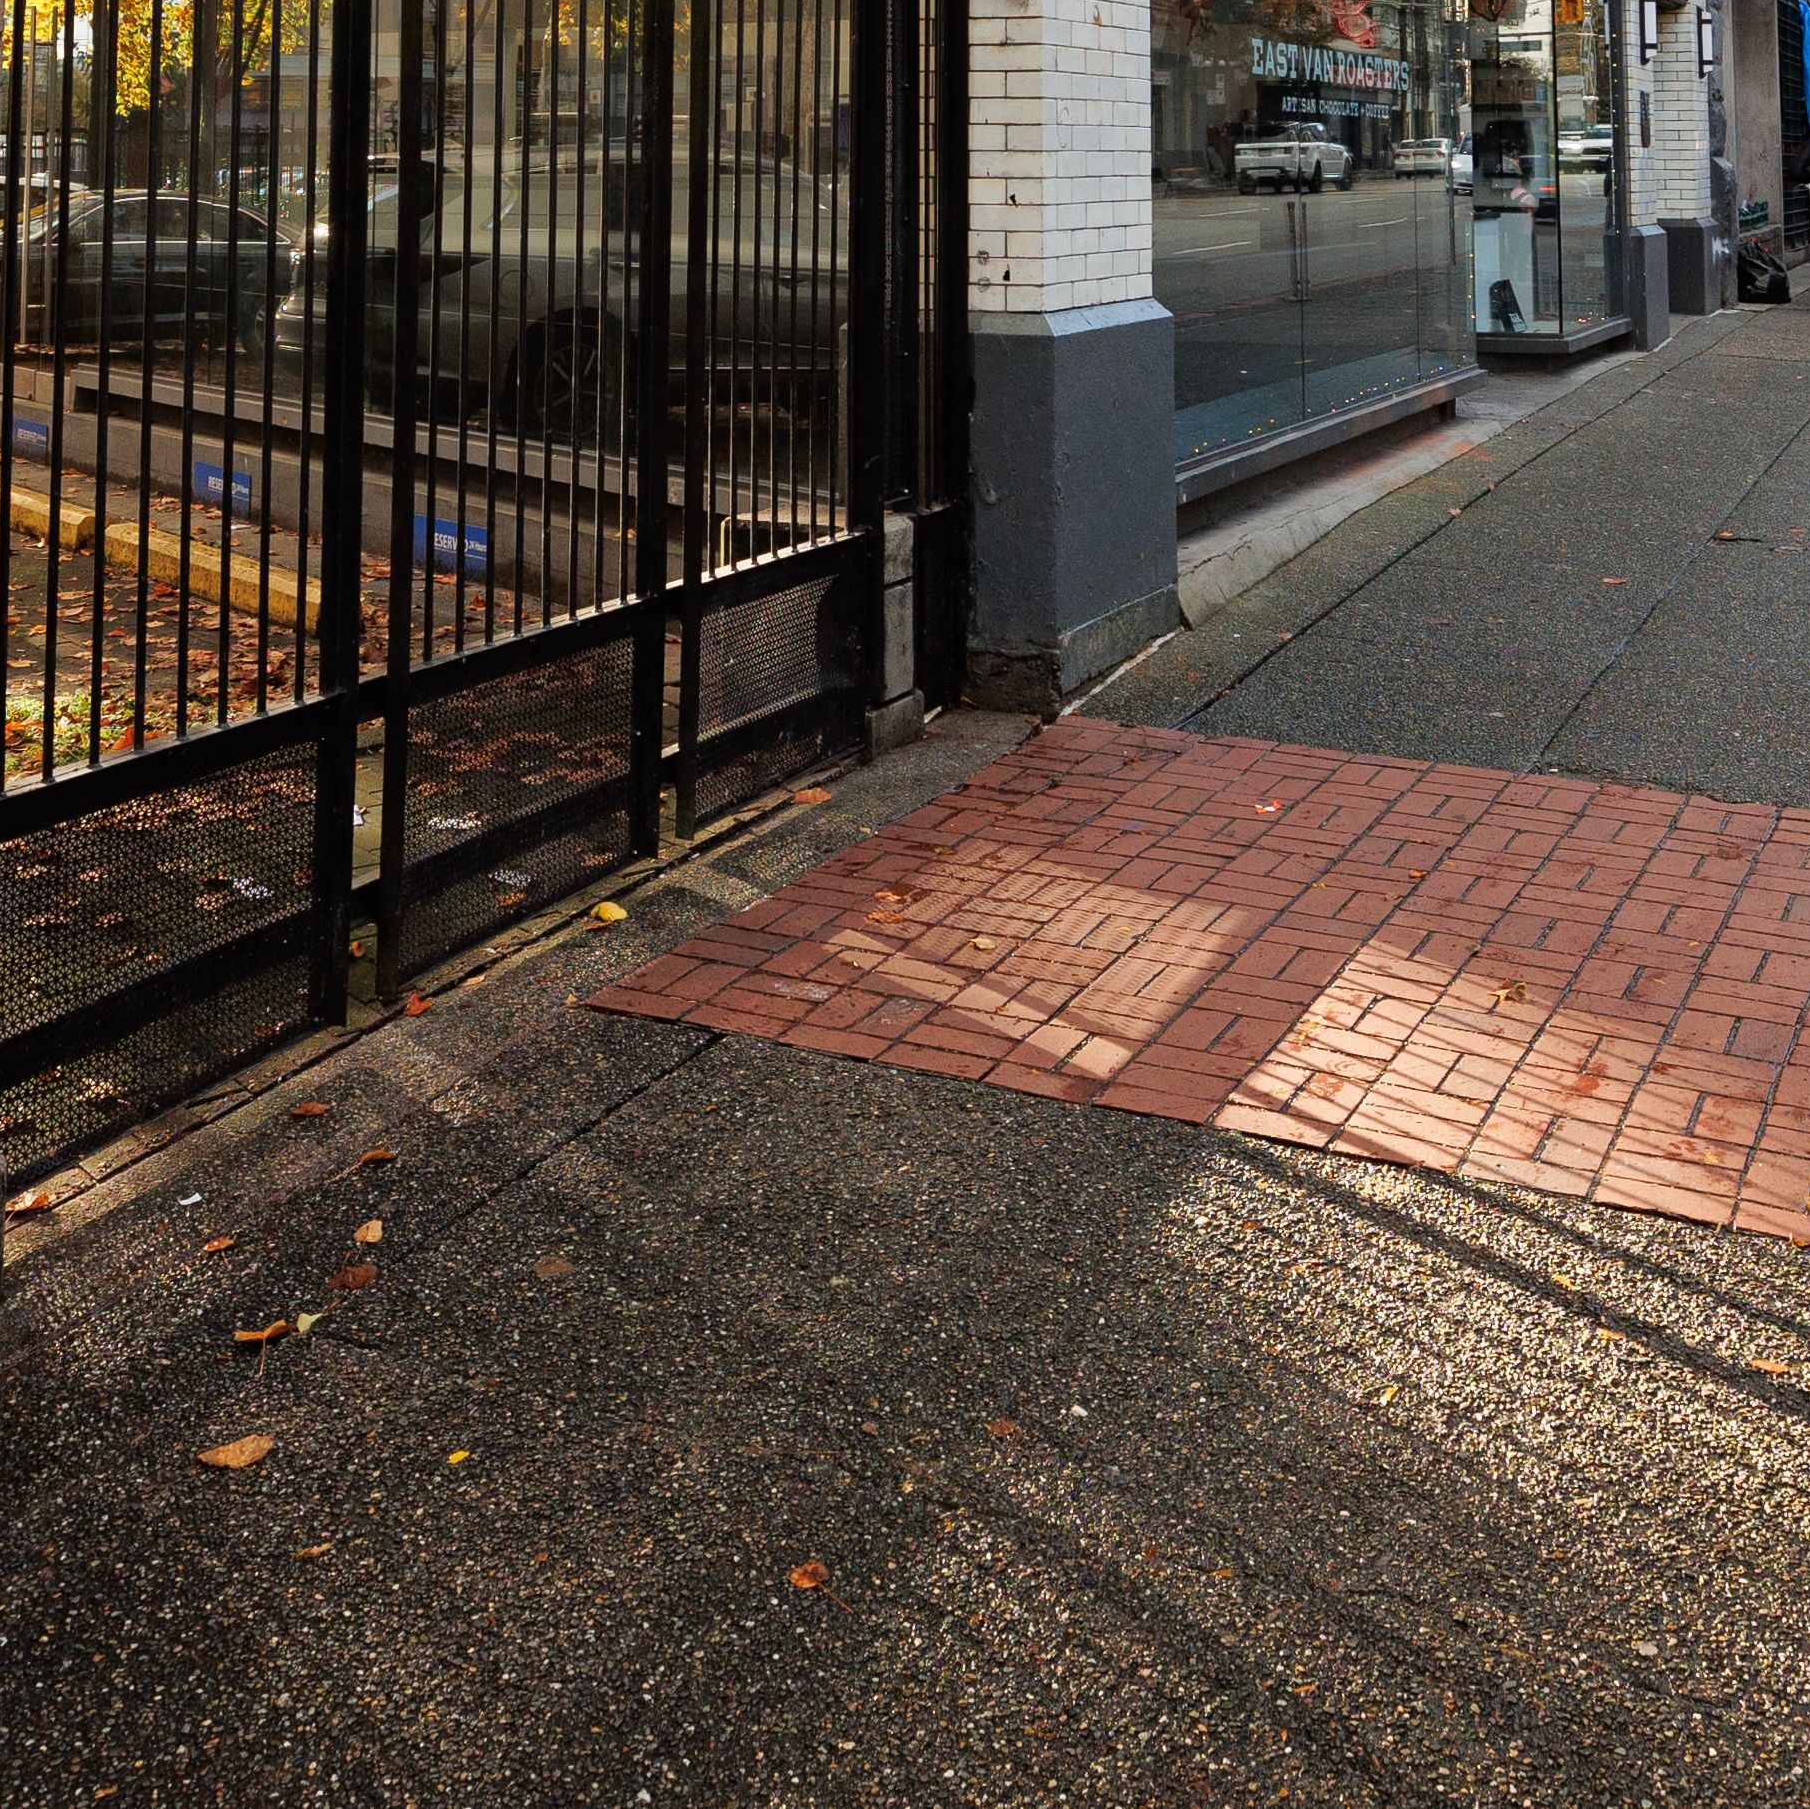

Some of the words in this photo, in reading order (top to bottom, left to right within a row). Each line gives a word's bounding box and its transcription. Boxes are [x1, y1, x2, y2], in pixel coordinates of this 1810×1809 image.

[1251, 37, 1298, 79] EAST
[1302, 45, 1334, 83] VAN
[1336, 51, 1410, 91] ROASTERS
[1319, 100, 1359, 116] CHOCOLATE
[1365, 103, 1390, 119] COFFEE
[434, 532, 469, 552] ESERVD
